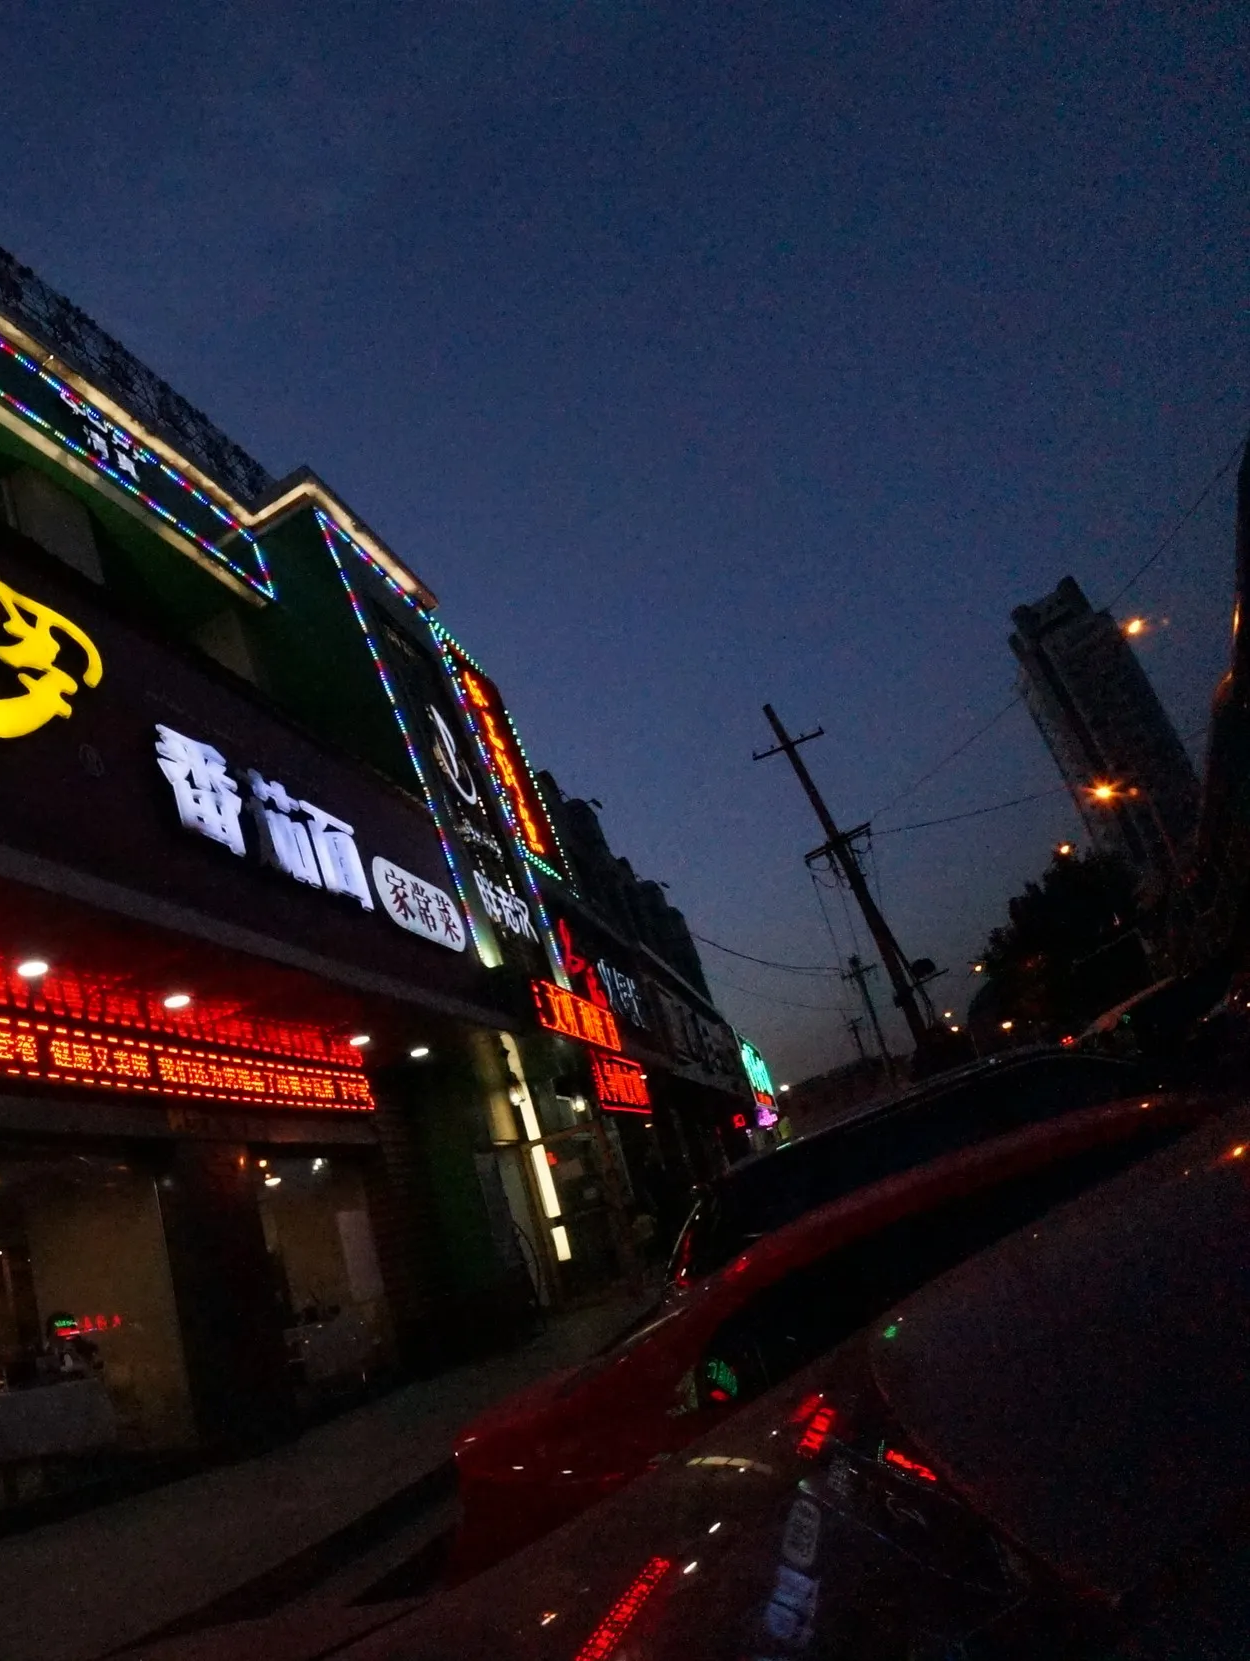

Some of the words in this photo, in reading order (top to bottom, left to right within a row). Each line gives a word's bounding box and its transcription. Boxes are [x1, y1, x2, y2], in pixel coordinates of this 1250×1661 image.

[154, 723, 374, 912] 番茄
[384, 869, 461, 943] 家常菜
